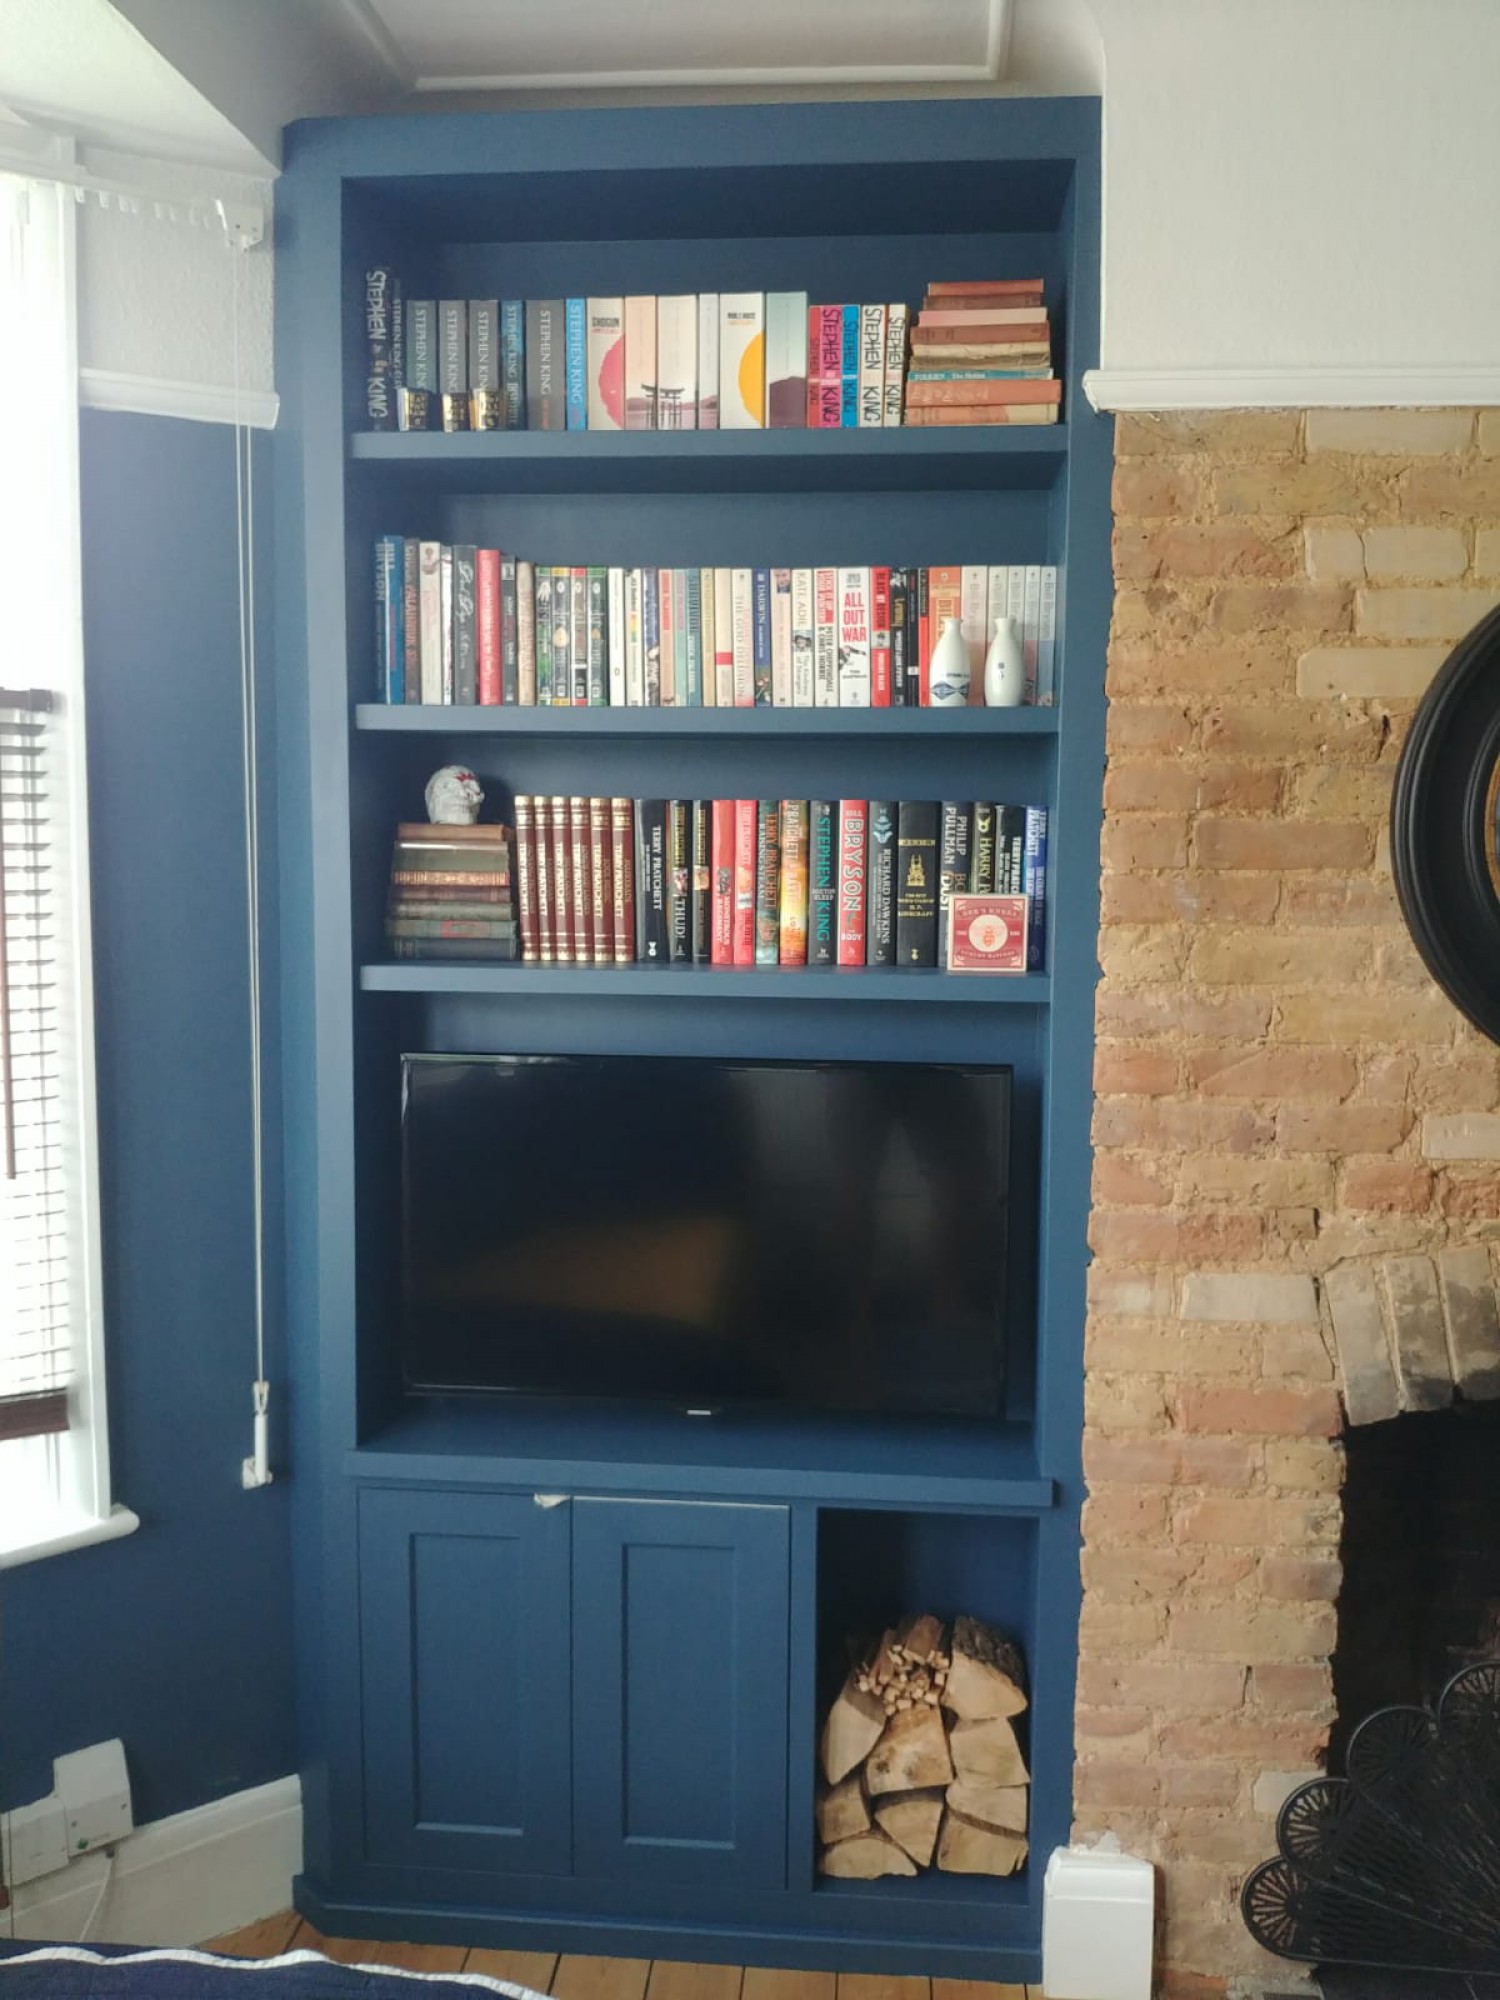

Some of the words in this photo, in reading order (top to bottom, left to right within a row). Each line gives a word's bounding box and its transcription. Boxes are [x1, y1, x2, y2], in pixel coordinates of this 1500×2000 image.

[366, 270, 386, 339] STEPHEN
[415, 308, 427, 360] STEPHEN
[446, 309, 459, 360] STEPHEN
[478, 311, 489, 362] STEPHEN
[540, 309, 551, 361] STEPHEN
[570, 304, 583, 365] STEPHEN
[823, 308, 841, 371] STEPHEN
[843, 320, 859, 371] STEPHEN
[863, 307, 883, 370] STEPHEN
[888, 316, 905, 370] STEPHEN
[508, 351, 518, 379] KING
[540, 364, 551, 395] KING
[570, 368, 583, 403] KING
[367, 376, 388, 417] KING
[822, 386, 840, 423] KING
[843, 382, 858, 413] KING
[863, 385, 881, 422] KING
[884, 384, 902, 415] KING
[843, 609, 866, 625] OUT
[845, 592, 865, 607] ALL
[736, 618, 746, 642] GOD
[842, 626, 868, 642] WAR
[653, 825, 662, 853] TERRY
[758, 822, 766, 859] RAISING
[764, 813, 778, 844] TERRY
[785, 804, 801, 859] PRATCHETT
[944, 806, 957, 865] PULLMAN
[956, 815, 968, 855] PHILIP
[1028, 809, 1041, 856] PRATCHETT
[519, 843, 527, 868] TERRY
[538, 843, 546, 868] TERRY
[556, 843, 564, 868] TERRY
[594, 843, 602, 868] TERRY
[614, 843, 623, 868] TERRY
[817, 817, 831, 888] STEPHEN
[843, 818, 864, 911] BRYSON
[979, 837, 993, 879] HARRY
[1012, 836, 1022, 863] TERRY
[653, 857, 662, 911] PRATCHETT
[758, 862, 766, 898] STEAM
[764, 847, 778, 908] PRATCHETT
[882, 848, 891, 895] RICHARD
[520, 869, 529, 917] PRATCHETT
[539, 869, 548, 917] PRATCHETT
[555, 869, 566, 917] PRATCHETT
[574, 869, 583, 917] PRATCHETT
[594, 869, 604, 917] PRATCHETT
[614, 869, 624, 917] PRATCHETT
[940, 875, 954, 911] DUST
[675, 898, 686, 938] THUD!
[817, 902, 831, 941] KING
[881, 896, 891, 943] DAWKINS
